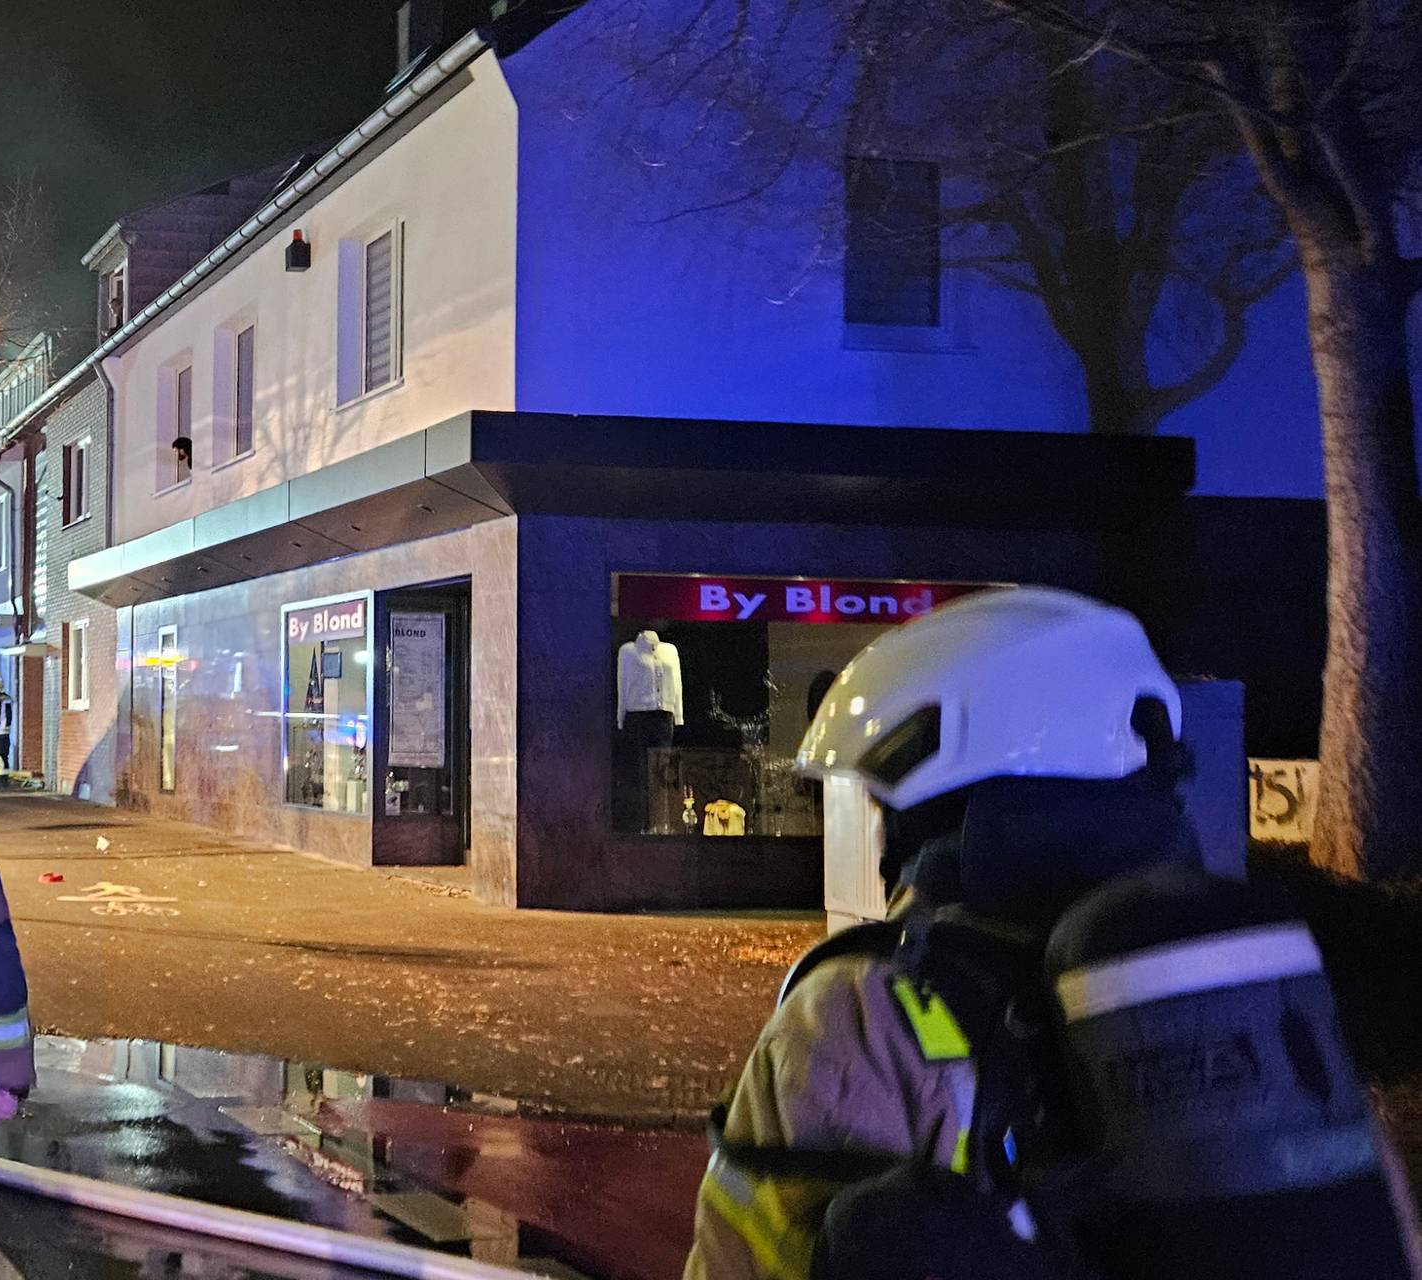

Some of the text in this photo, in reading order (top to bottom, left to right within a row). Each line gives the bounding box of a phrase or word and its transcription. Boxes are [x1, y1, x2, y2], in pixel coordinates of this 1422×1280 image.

[700, 584, 934, 619] By Blond
[289, 604, 363, 641] By Blond
